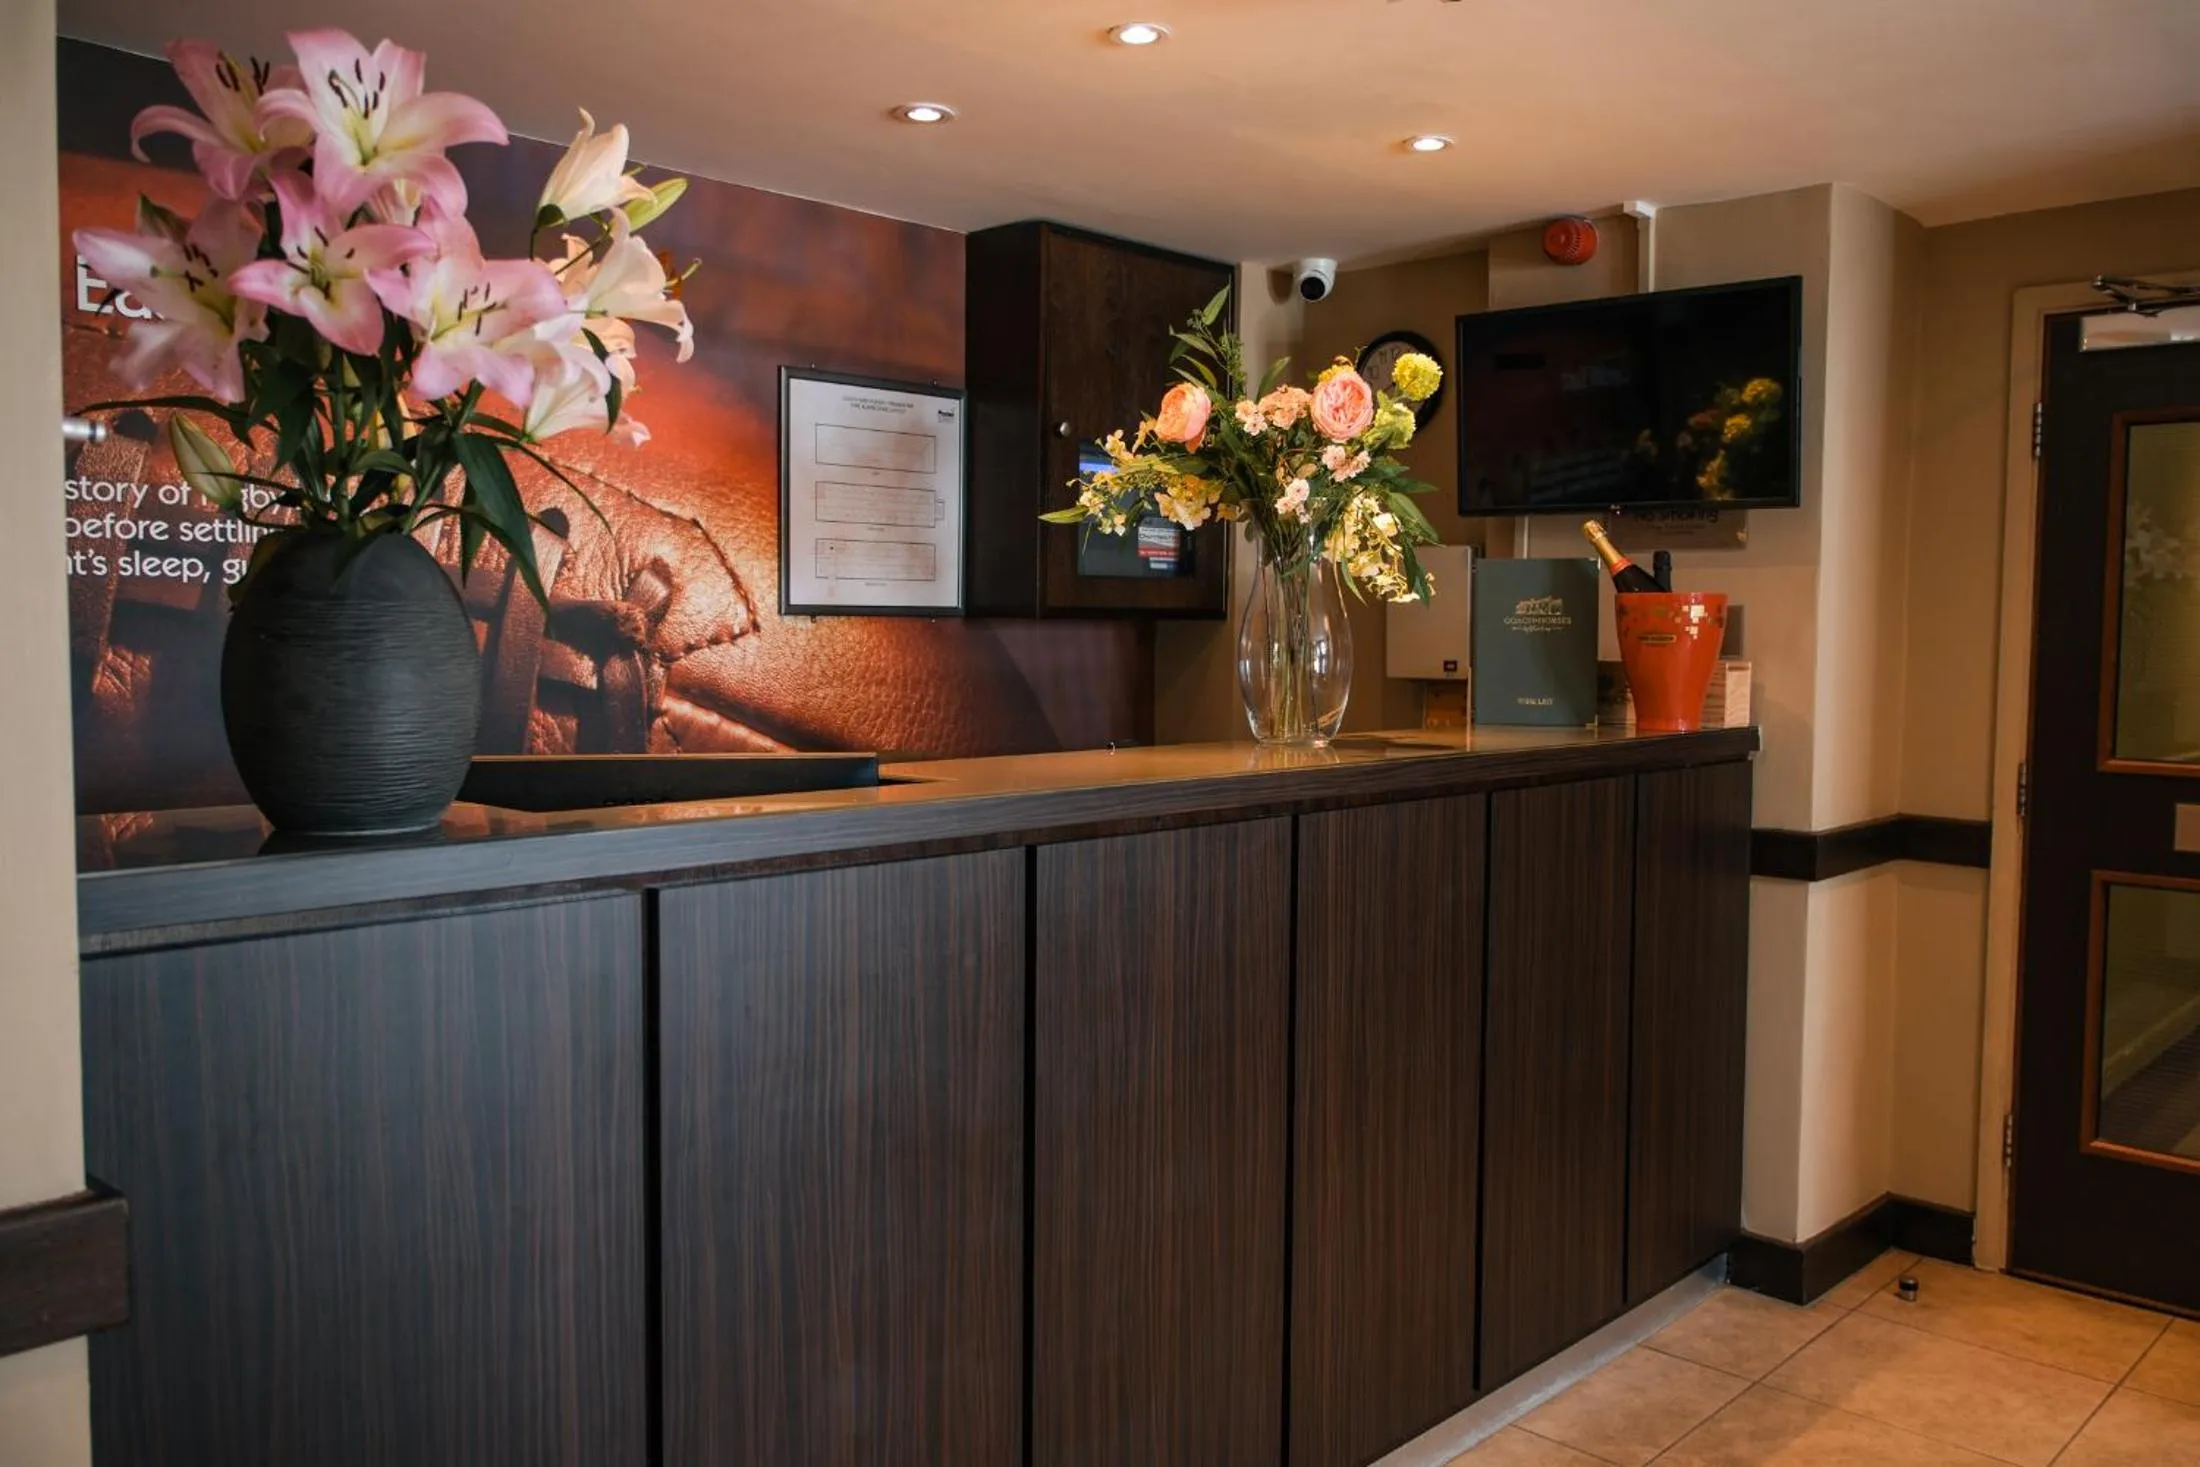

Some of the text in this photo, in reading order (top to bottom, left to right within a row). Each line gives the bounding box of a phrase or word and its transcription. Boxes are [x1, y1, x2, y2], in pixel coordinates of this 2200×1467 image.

[64, 475, 148, 508] story
[179, 518, 283, 544] settlin
[118, 550, 211, 584] sleep,
